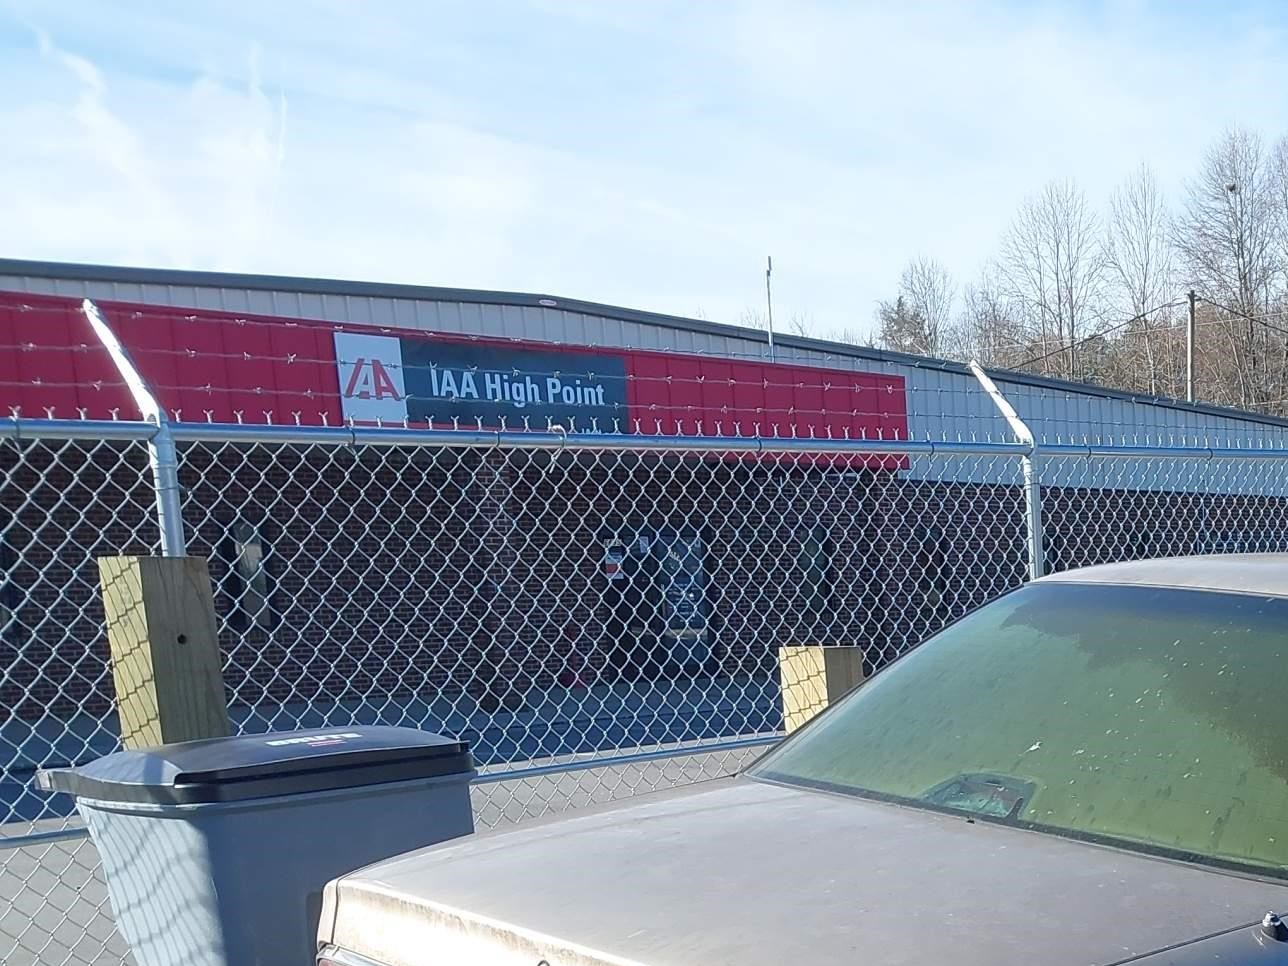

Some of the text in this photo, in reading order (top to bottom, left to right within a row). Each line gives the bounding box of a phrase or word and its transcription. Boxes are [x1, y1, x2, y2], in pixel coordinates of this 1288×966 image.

[430, 367, 606, 408] IAA High Point
